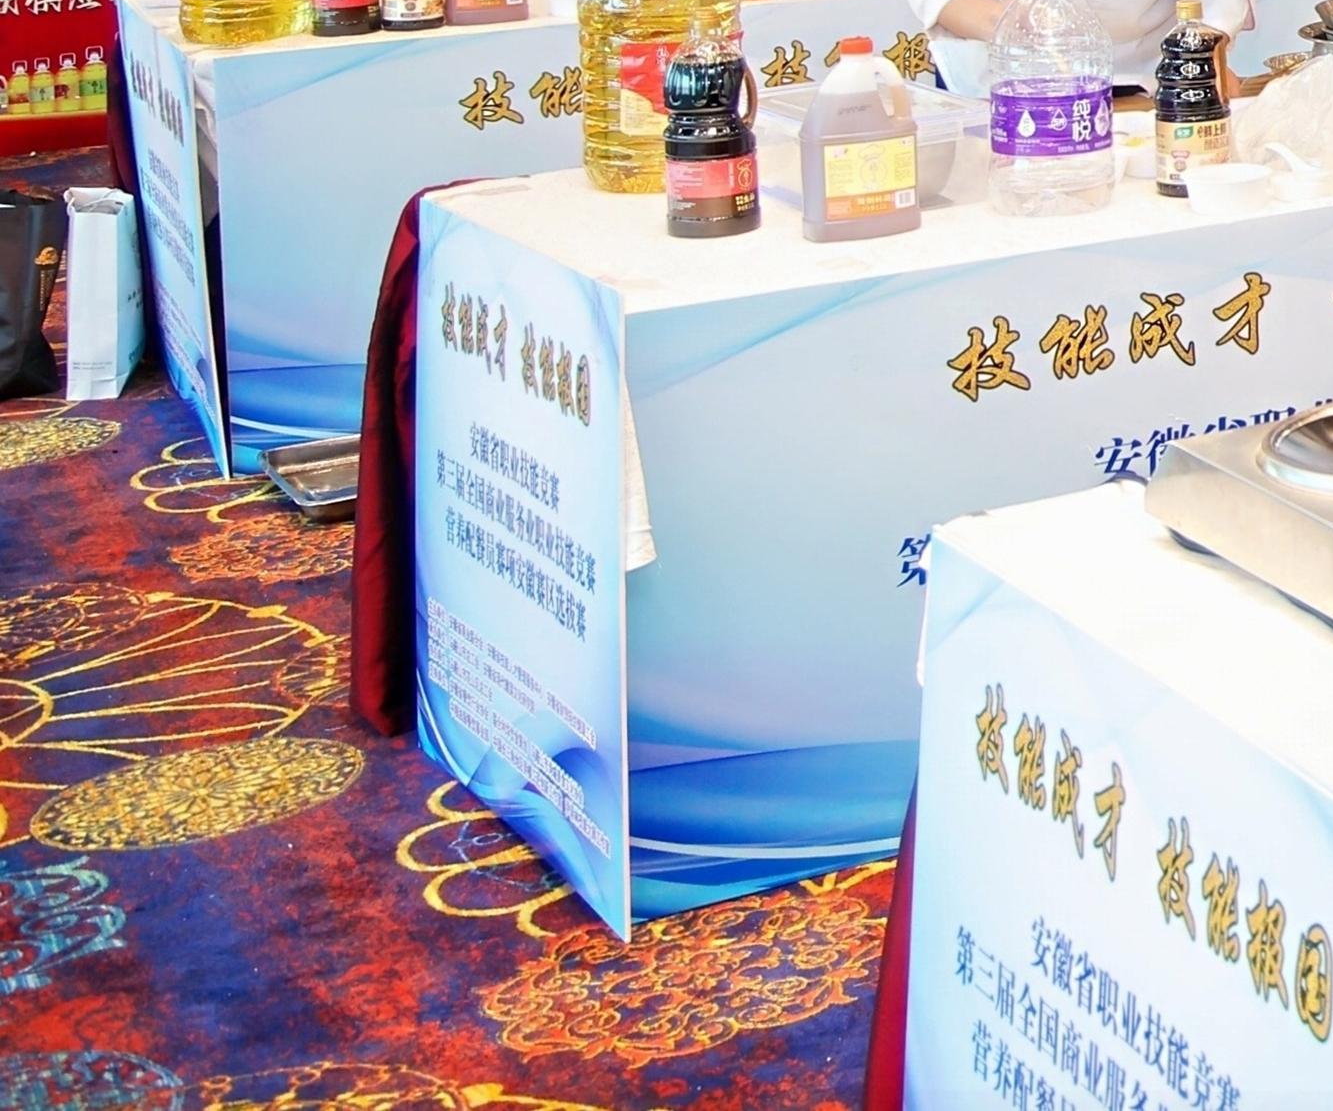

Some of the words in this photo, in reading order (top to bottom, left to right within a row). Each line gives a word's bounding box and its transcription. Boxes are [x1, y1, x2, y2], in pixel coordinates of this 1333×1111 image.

[459, 66, 584, 130] 技能
[1071, 98, 1093, 143] 纯悦
[441, 280, 508, 382] 技能成才
[519, 320, 593, 429] 技能报国
[947, 271, 1272, 402] 技能成才
[435, 448, 596, 596] 第三届全国商业服务业职业技能竞赛
[469, 419, 560, 516] 安徽省职业技能竞赛
[444, 505, 587, 644] 营养配餐员赛项安徽赛区选拔赛
[976, 682, 1126, 882] 技能成才
[1157, 815, 1333, 1043] 技能报国
[955, 924, 1170, 1111] 第三届全国商业服务
[1031, 914, 1242, 1111] 安徽省职业技能竞赛
